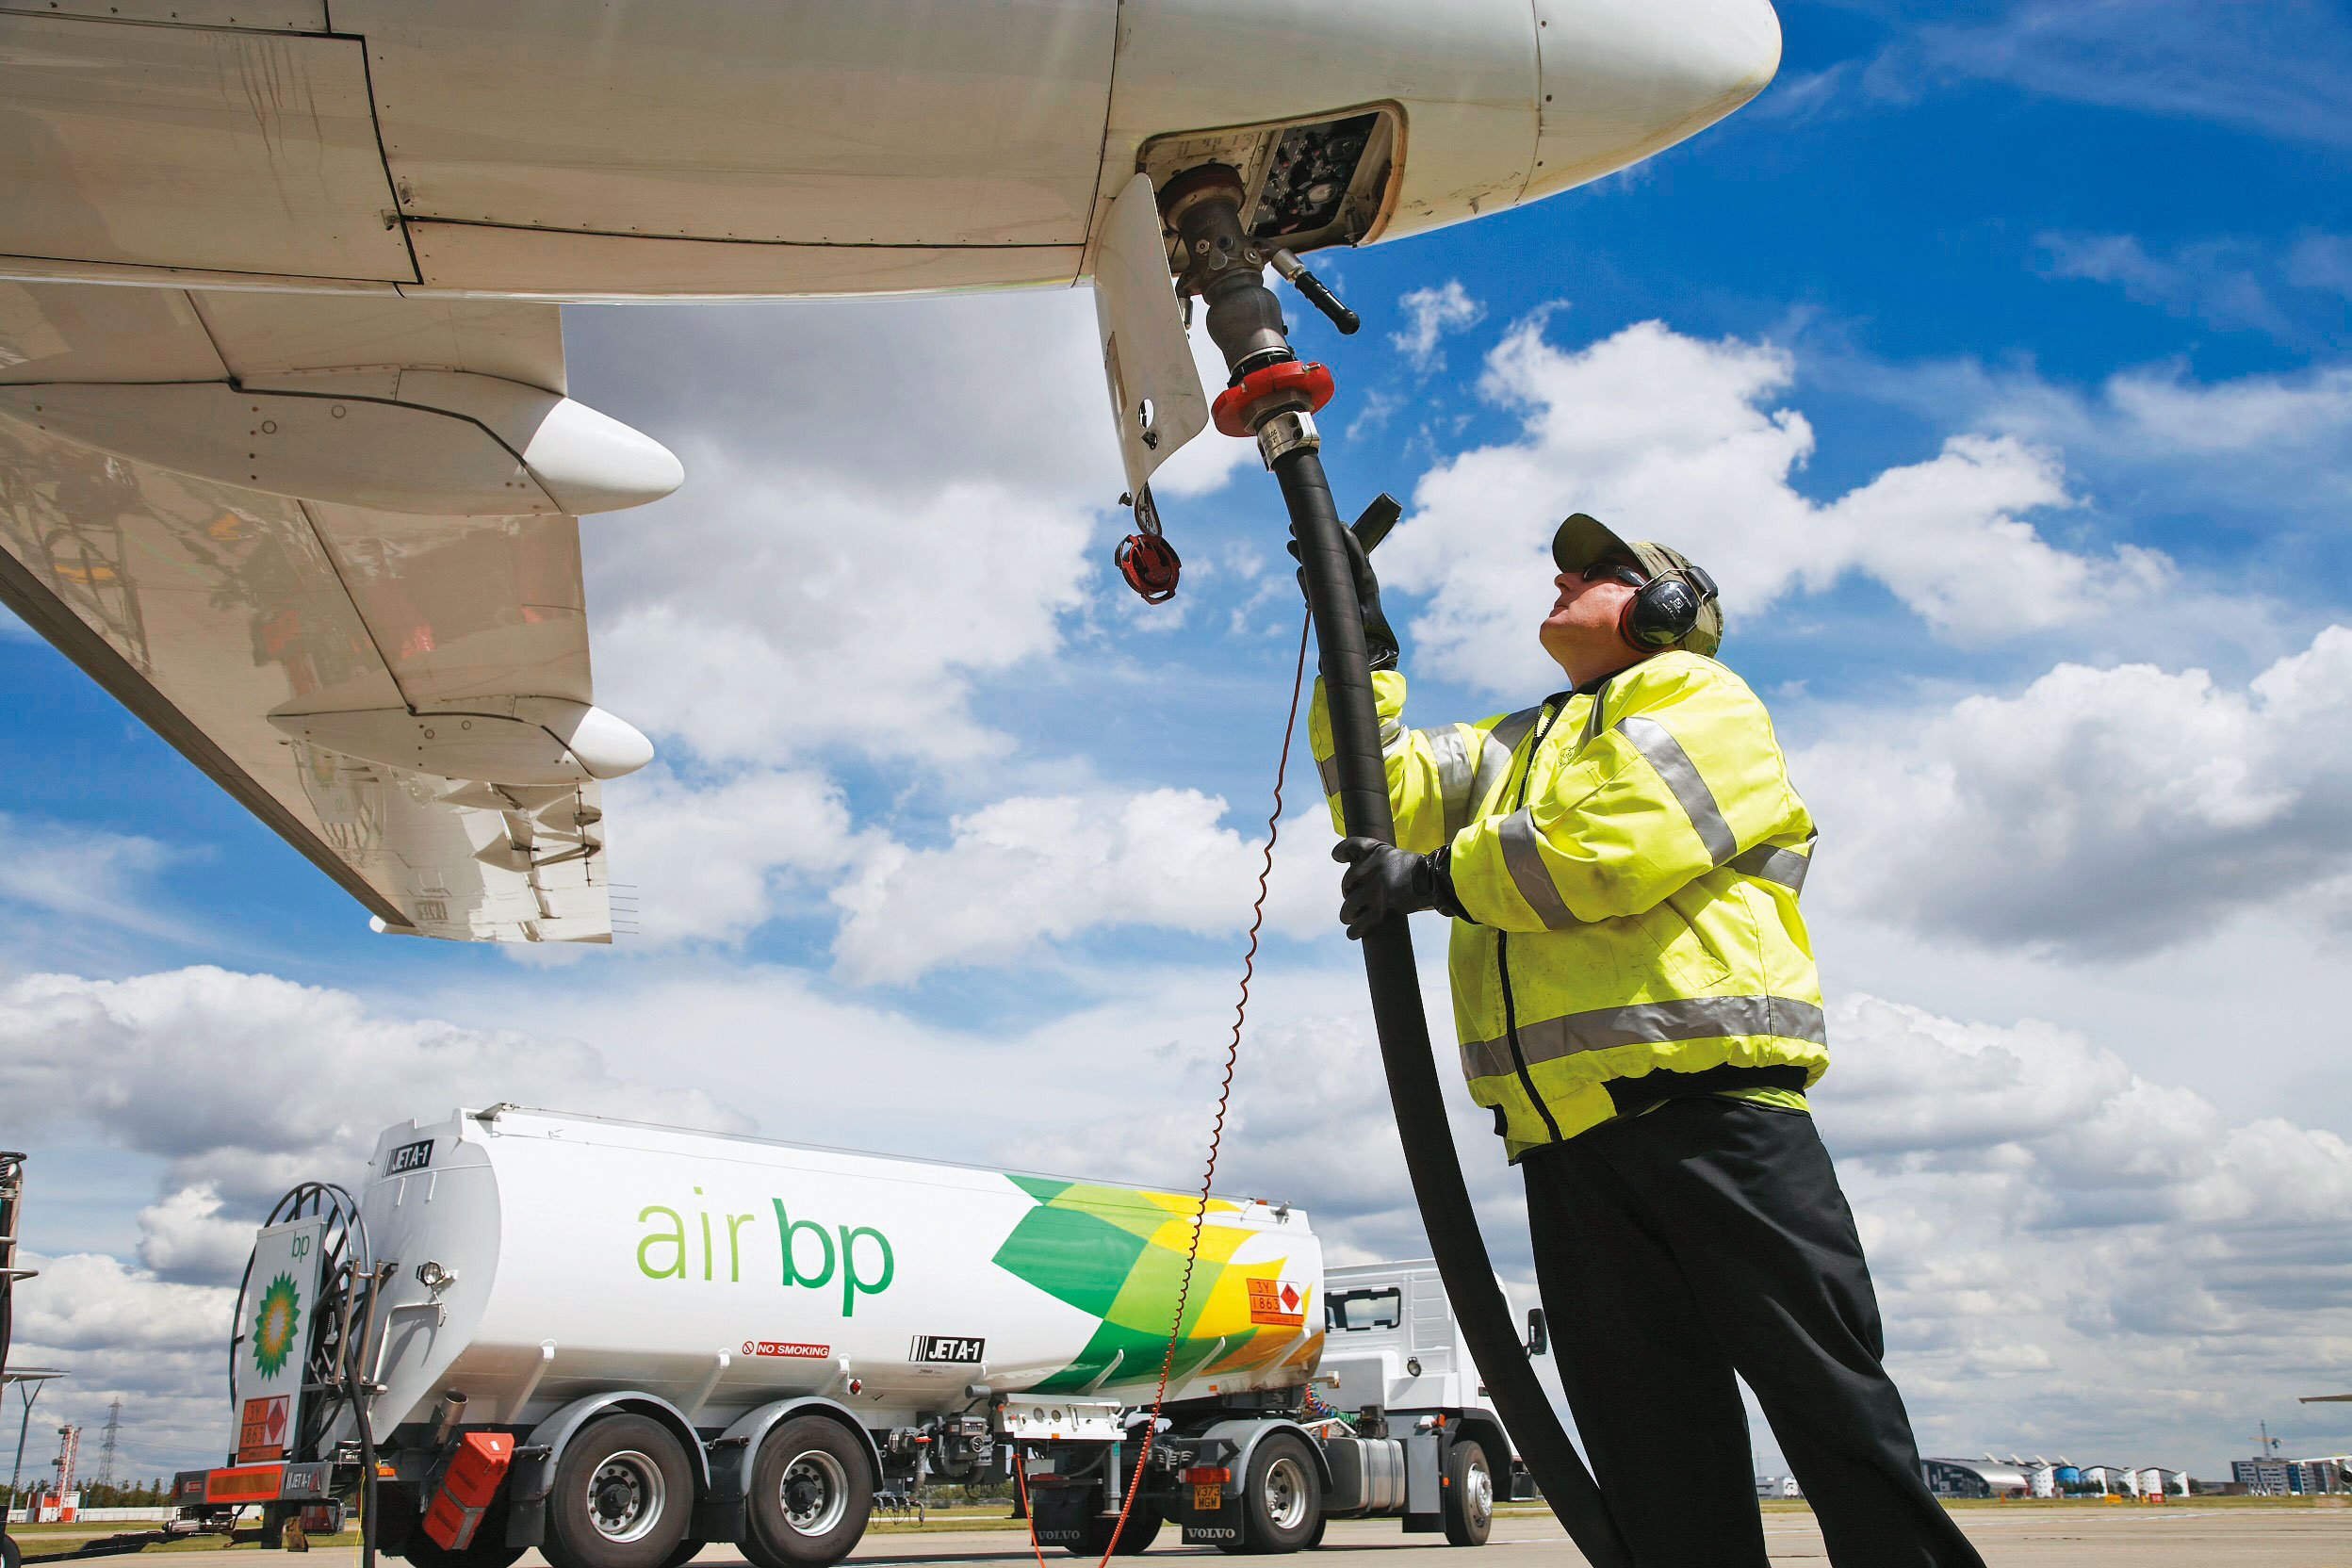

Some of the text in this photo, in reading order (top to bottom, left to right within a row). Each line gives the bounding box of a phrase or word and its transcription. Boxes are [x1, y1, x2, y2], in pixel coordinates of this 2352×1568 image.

[291, 1231, 310, 1264] bp
[636, 1186, 894, 1317] air bp
[1256, 1282, 1270, 1294] 3Y
[1253, 1297, 1280, 1310] 1863
[758, 1344, 829, 1356] NO SMOKING
[1196, 1485, 1220, 1496] V373
[1037, 1529, 1081, 1540] VOLVO
[1186, 1527, 1236, 1539] VOLVO
